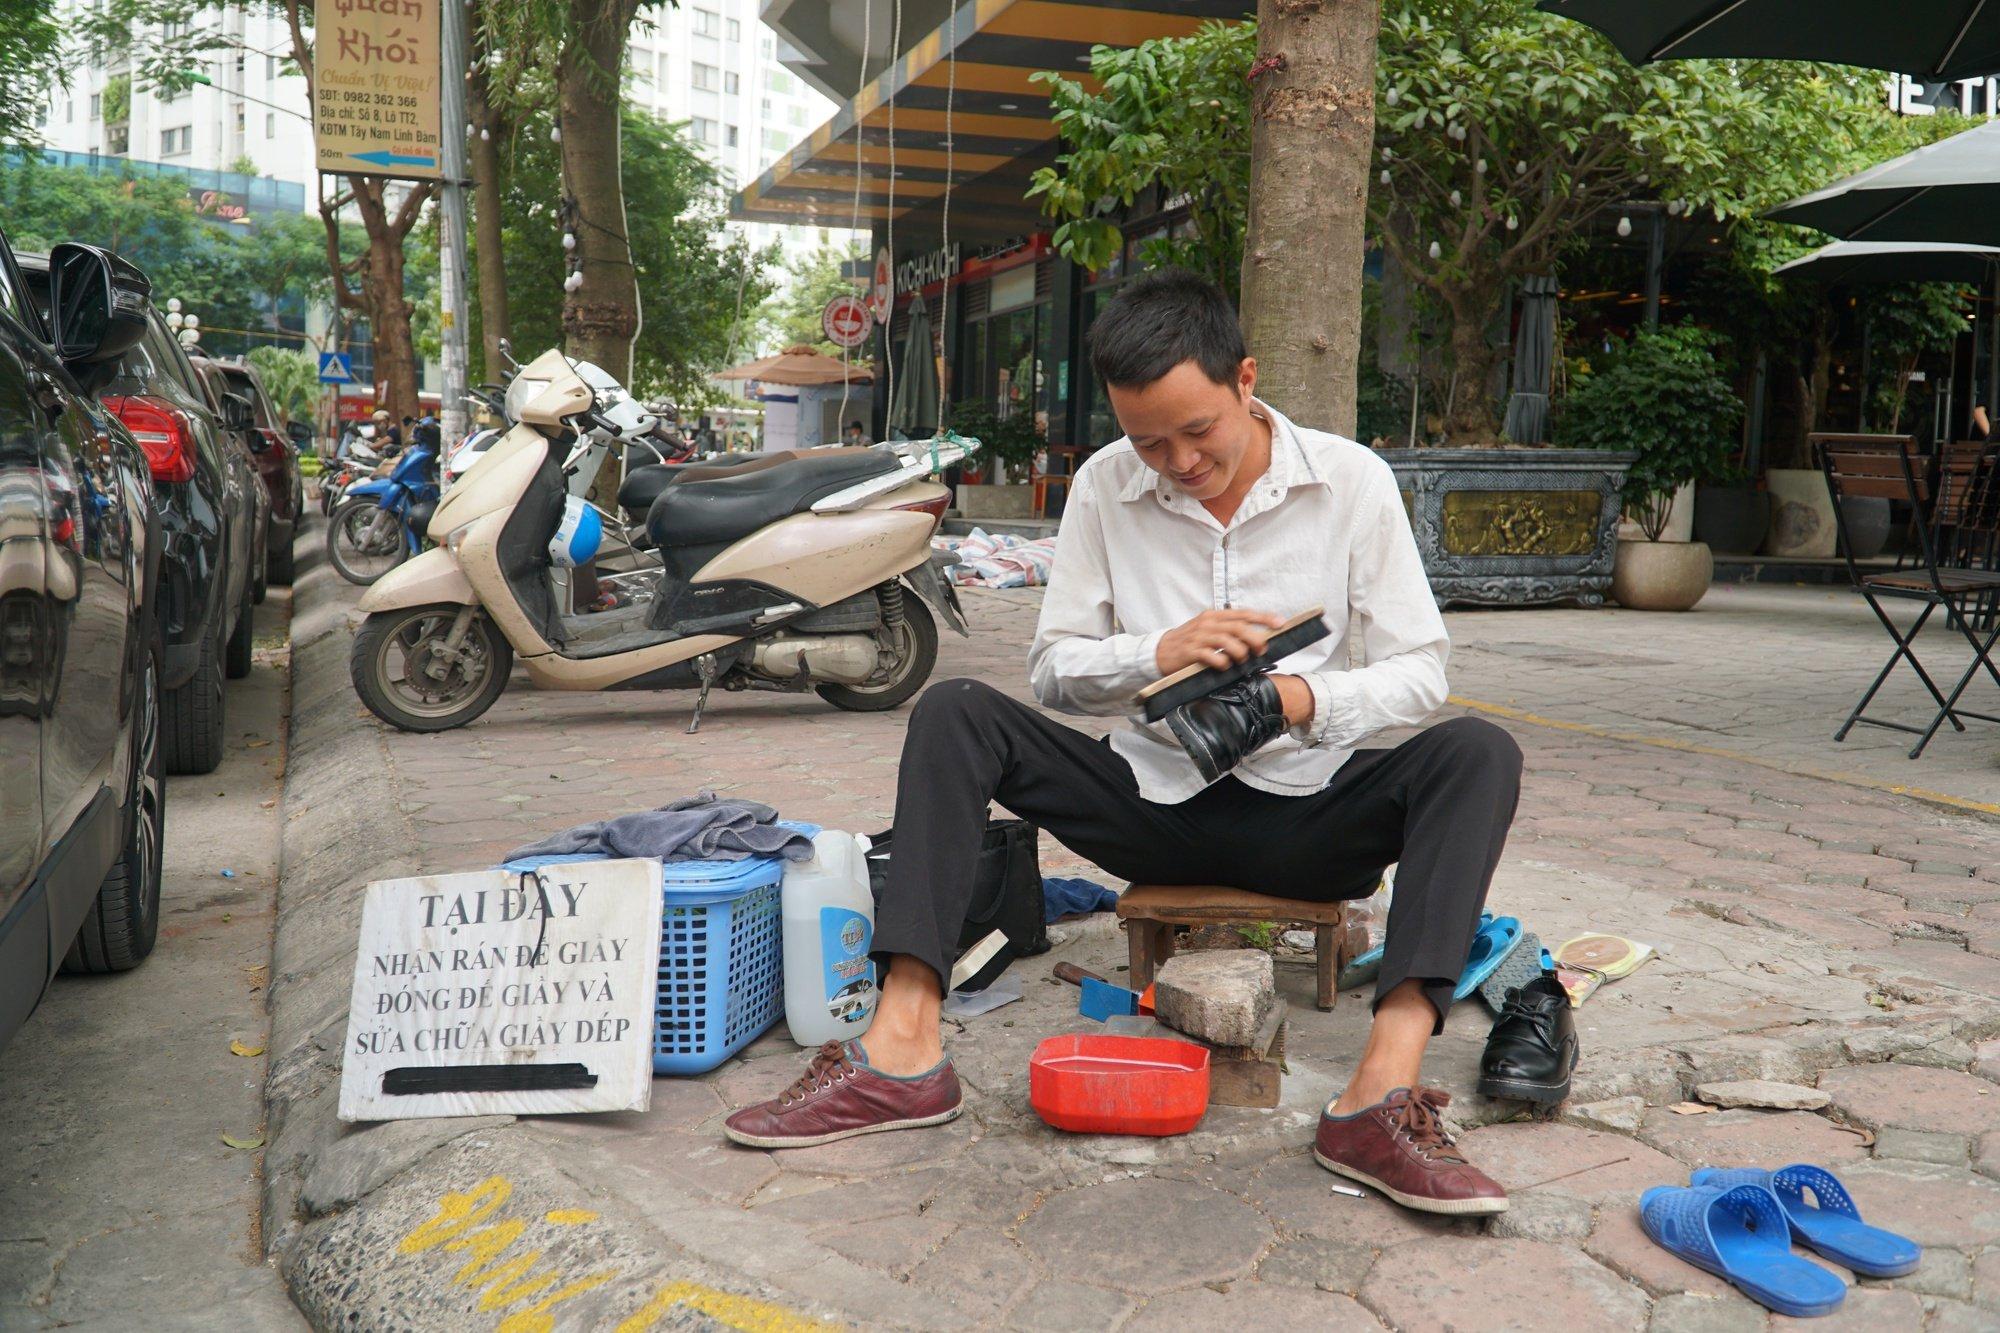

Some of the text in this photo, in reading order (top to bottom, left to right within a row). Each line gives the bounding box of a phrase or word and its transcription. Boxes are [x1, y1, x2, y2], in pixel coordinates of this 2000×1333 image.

[337, 27, 419, 65] Khói
[320, 89, 417, 107] SĐT: 0982 362 366
[321, 105, 335, 120] Địa
[358, 108, 370, 121] Số
[400, 111, 419, 126] TT2,
[320, 122, 347, 136] KĐTM
[350, 125, 367, 140] Tây
[370, 126, 391, 140] Nam
[394, 128, 413, 142] Linh
[320, 149, 343, 158] 50m
[419, 874, 588, 936] TẠI ĐÂY
[372, 947, 445, 981] NHẬN
[450, 940, 508, 972] RÁN
[376, 984, 450, 1015] ĐÓNG
[458, 979, 493, 1010] ĐẾ
[578, 972, 614, 1003] VÀ
[355, 1025, 405, 1056] SỬA
[414, 1021, 490, 1052] CHỮA
[575, 1011, 630, 1043] DÉP
